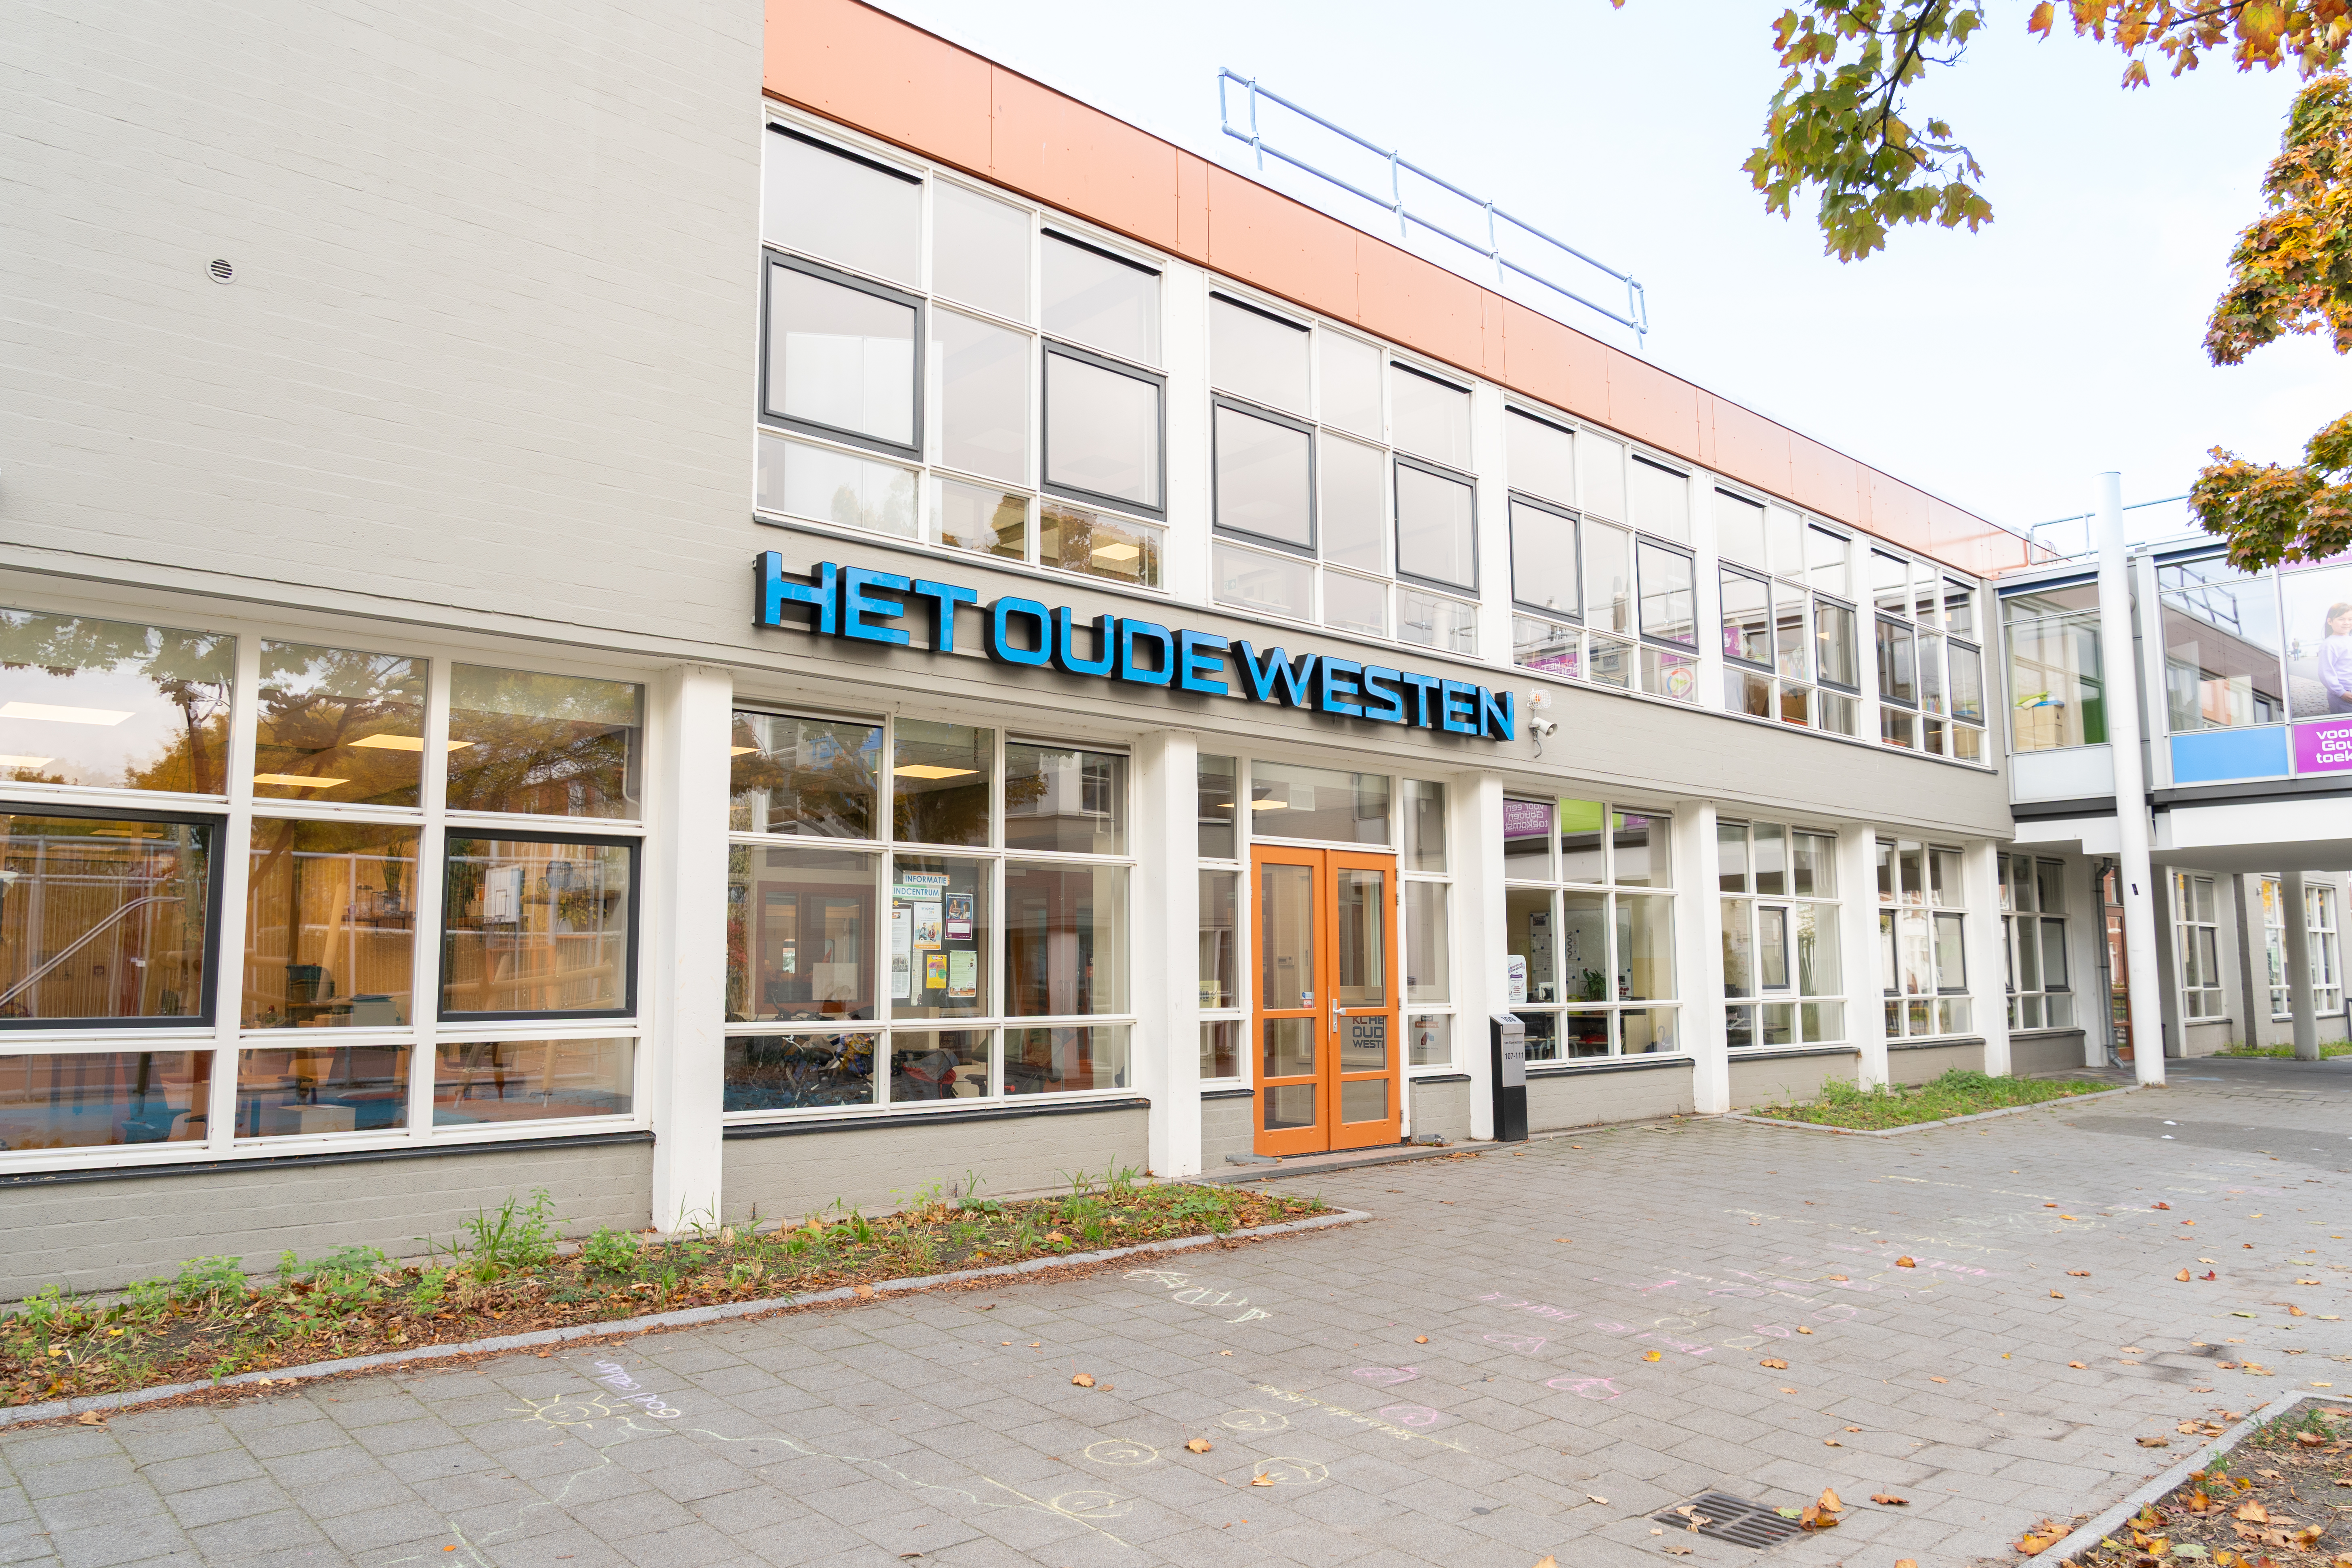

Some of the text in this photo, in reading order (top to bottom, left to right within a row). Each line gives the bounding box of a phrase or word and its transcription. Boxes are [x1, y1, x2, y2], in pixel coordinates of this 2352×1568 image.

[755, 550, 1515, 741] HET OUDE WESTEN
[905, 875, 947, 884] INFORMATIE
[892, 887, 939, 896] INDCENTRUM
[1352, 1026, 1383, 1038] OUD
